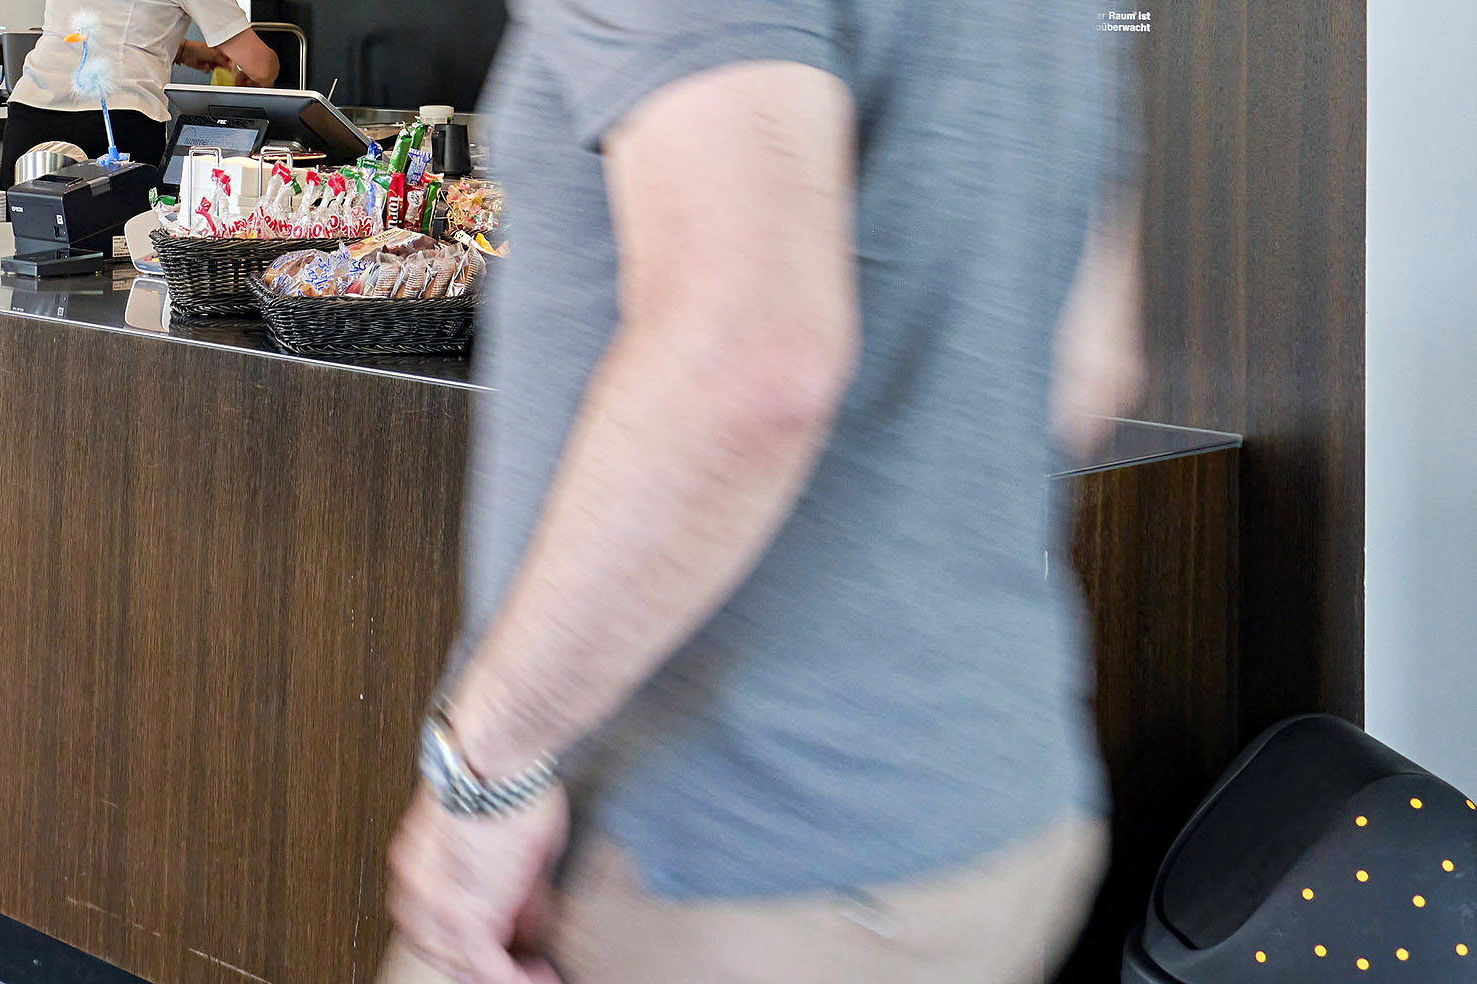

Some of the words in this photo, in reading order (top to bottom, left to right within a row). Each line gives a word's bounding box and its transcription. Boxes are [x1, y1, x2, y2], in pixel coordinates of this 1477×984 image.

[1108, 11, 1136, 21] Raum
[1138, 11, 1151, 21] ist
[1095, 22, 1151, 32] oüberwacht
